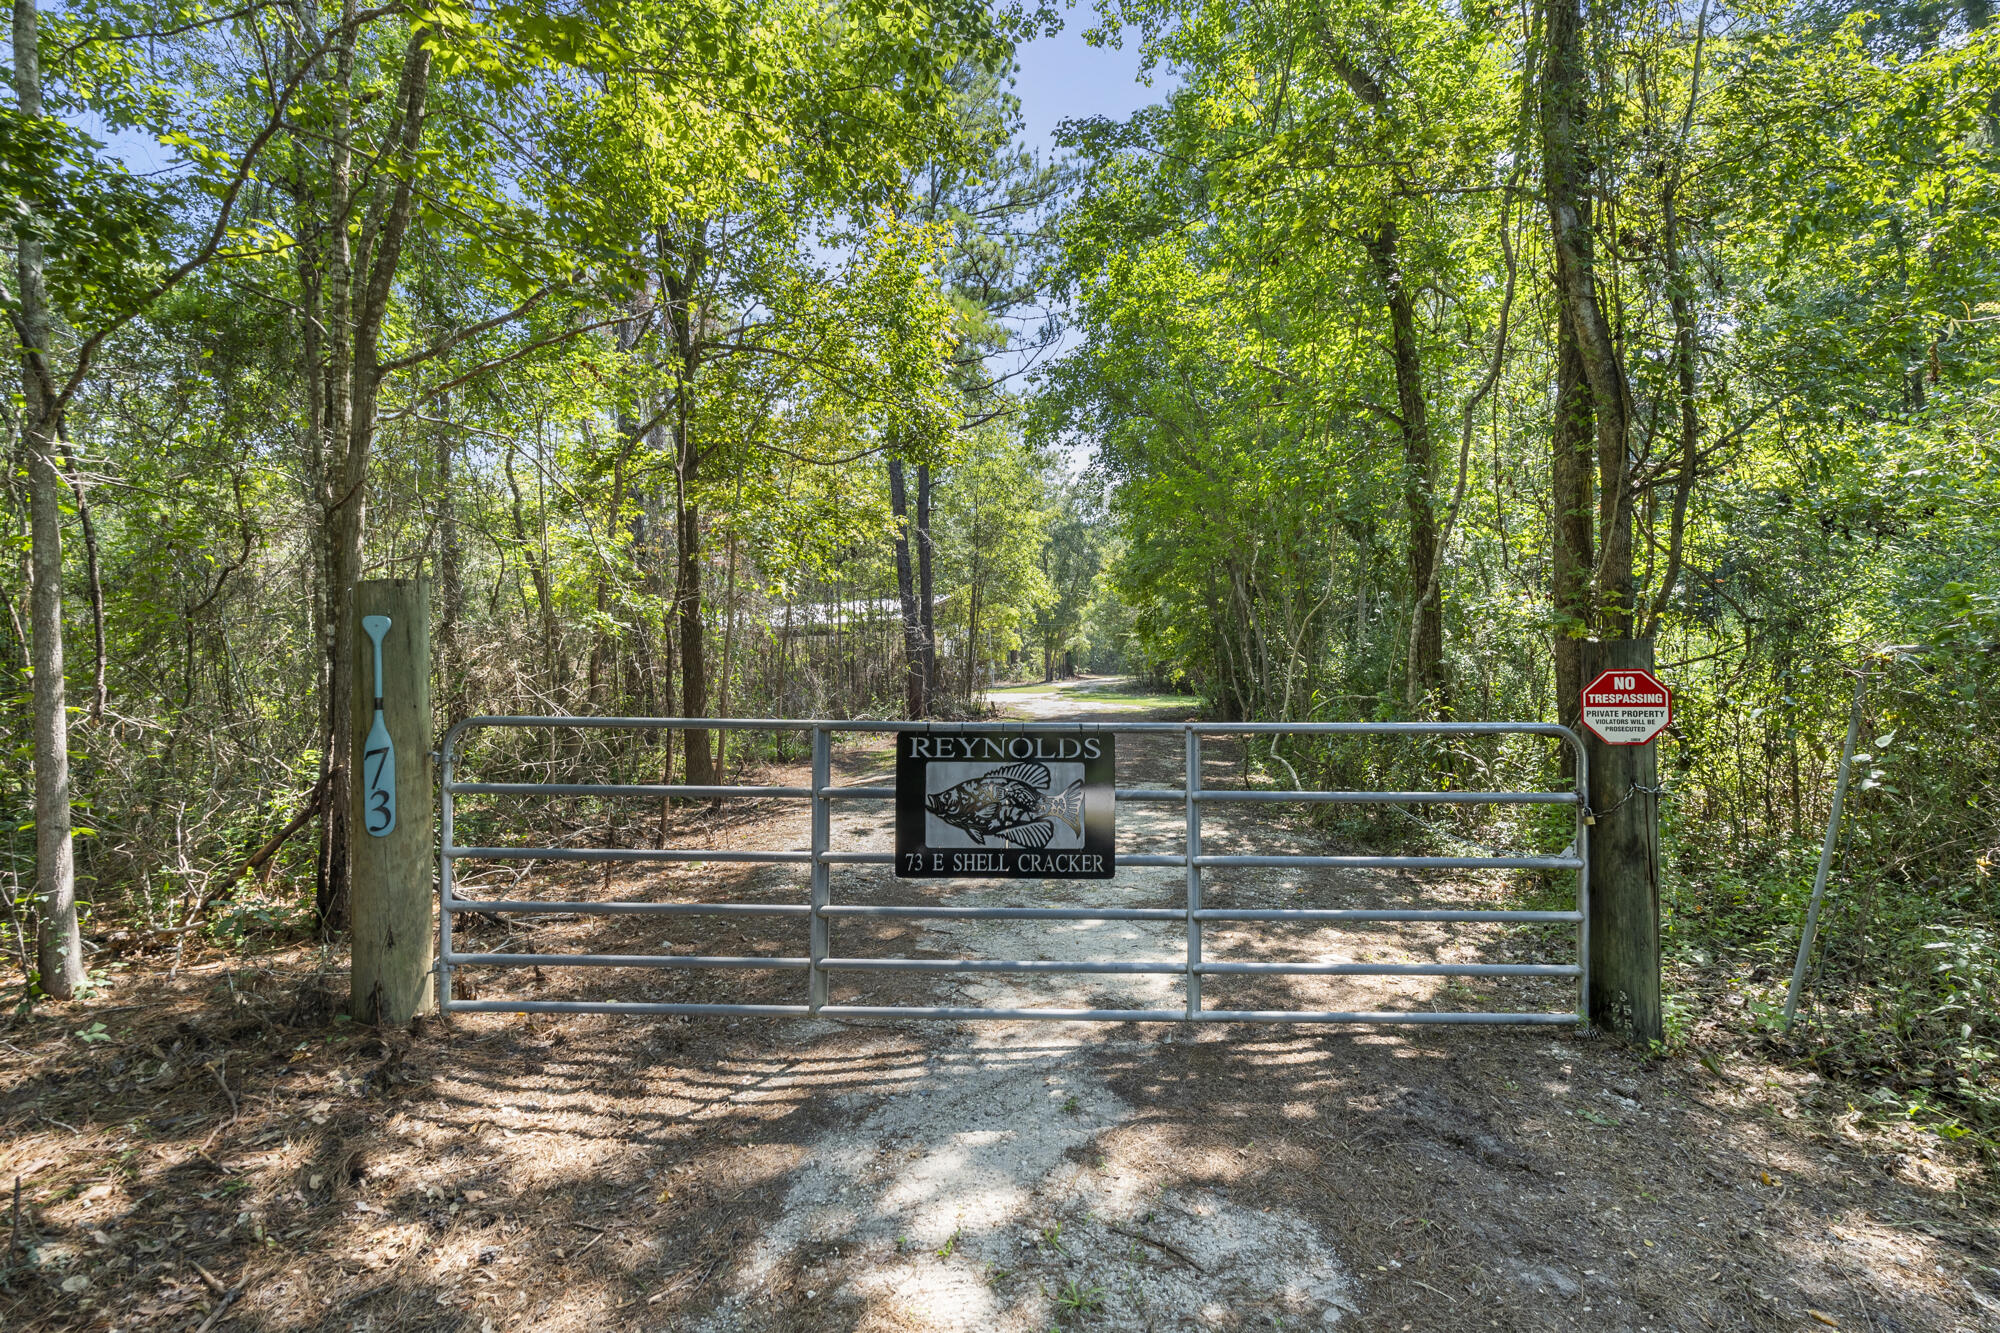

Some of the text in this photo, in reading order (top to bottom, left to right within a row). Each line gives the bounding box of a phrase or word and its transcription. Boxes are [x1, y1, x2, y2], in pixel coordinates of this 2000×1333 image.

[1613, 676, 1635, 690] NO
[1588, 693, 1663, 704] TRESPASSING
[1586, 710, 1665, 718] PRIVATE PROPERTY
[908, 736, 1101, 759] REYNOLDS
[364, 747, 392, 832] 73
[905, 853, 1105, 873] 73 E SHELL CRACKER
